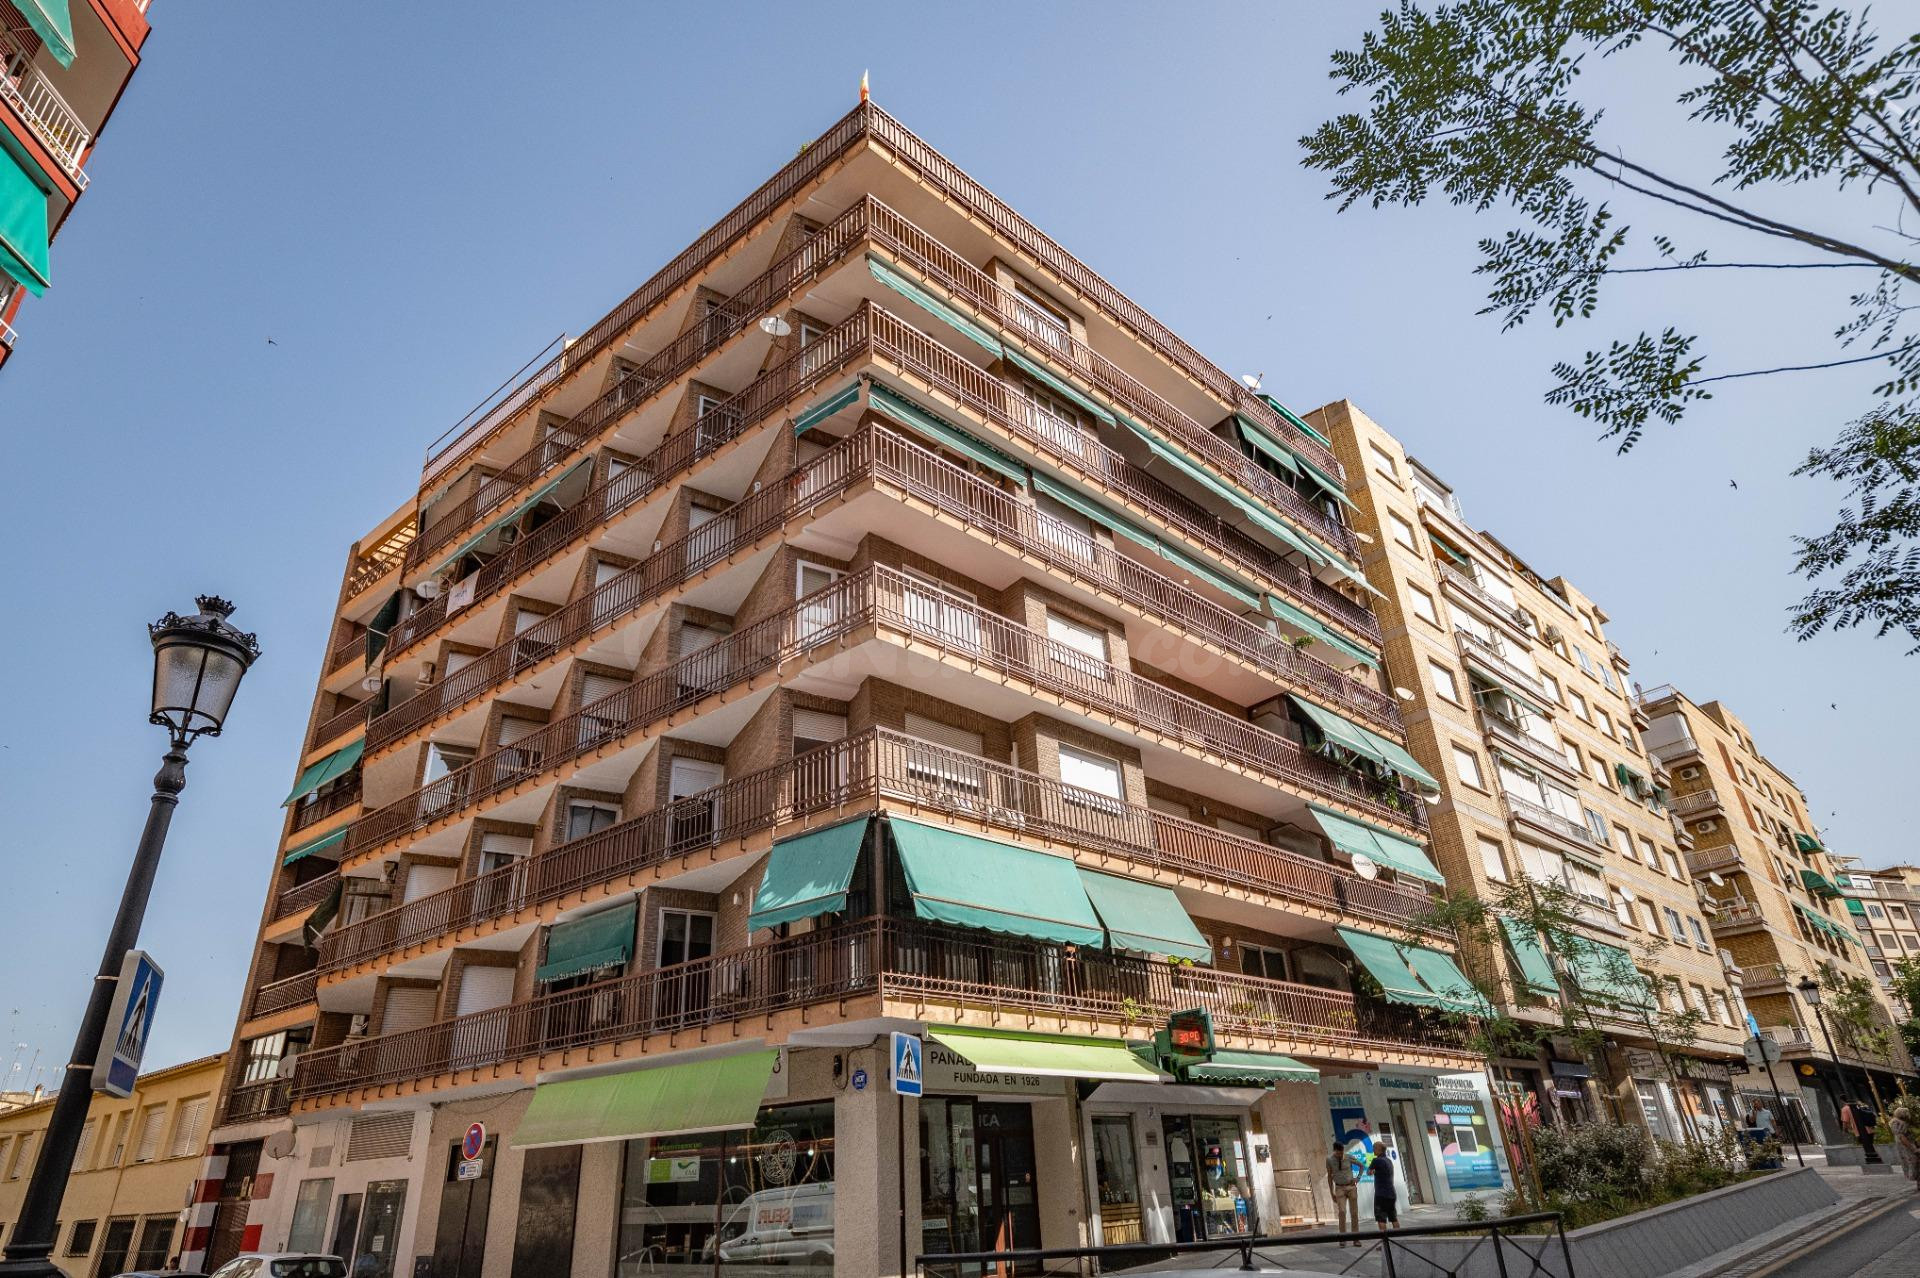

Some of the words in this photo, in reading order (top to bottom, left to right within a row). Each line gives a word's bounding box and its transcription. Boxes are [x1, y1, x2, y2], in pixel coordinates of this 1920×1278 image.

[953, 1072, 1000, 1085] FUNDADA
[1004, 1076, 1017, 1086] EN
[1021, 1076, 1040, 1087] 1926
